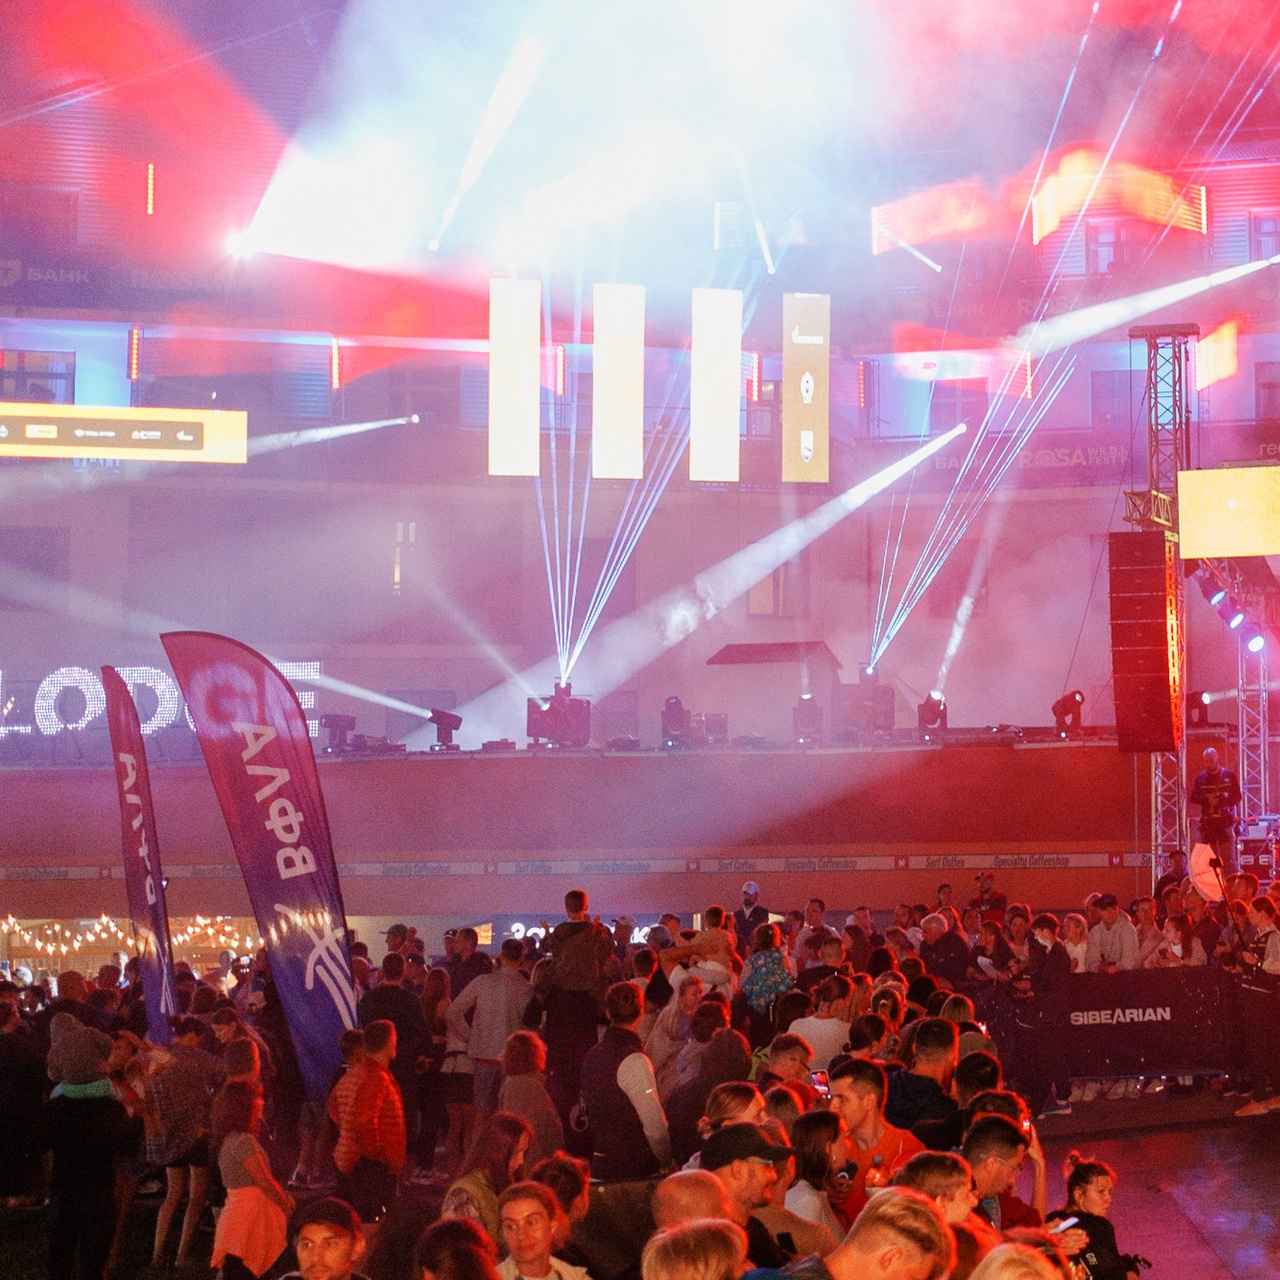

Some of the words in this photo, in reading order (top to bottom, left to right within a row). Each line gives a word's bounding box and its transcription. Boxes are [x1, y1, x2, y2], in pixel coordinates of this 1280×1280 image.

[1019, 449, 1087, 468] ROSA
[926, 856, 940, 868] Surf
[942, 856, 965, 868] Coffee
[994, 856, 1027, 868] Specialty
[1029, 855, 1070, 867] Coffeeshop
[1070, 1007, 1171, 1025] SIBEARIAN
